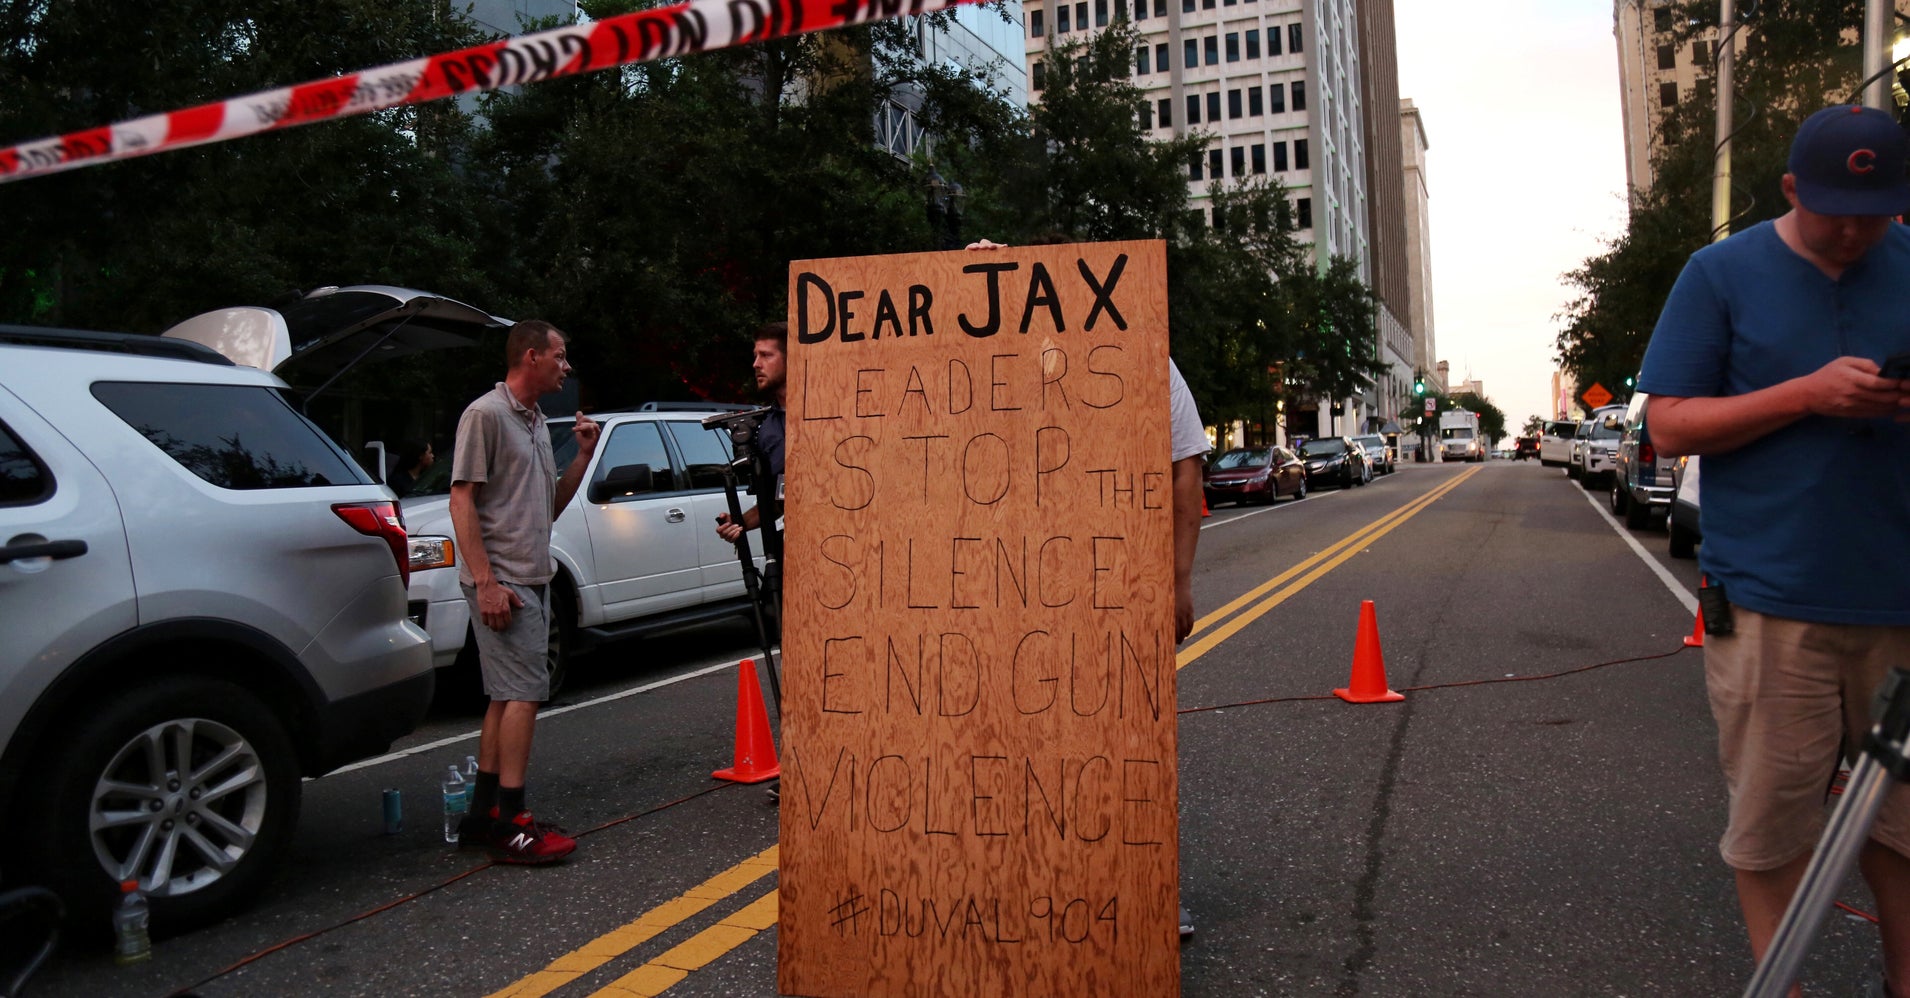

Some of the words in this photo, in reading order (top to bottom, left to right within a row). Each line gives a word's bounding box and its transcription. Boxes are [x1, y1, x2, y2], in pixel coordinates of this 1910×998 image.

[1847, 149, 1876, 174] C
[797, 272, 934, 344] DEAR
[958, 253, 1129, 339] JAX
[803, 345, 1125, 421] LEADERS
[831, 426, 1071, 511] STOP
[1085, 469, 1164, 509] THE
[814, 534, 1125, 610] SILENCE
[823, 632, 981, 717] END
[1012, 630, 1160, 722] GUN
[792, 746, 1164, 846] VIOLENCE
[508, 832, 535, 851] N
